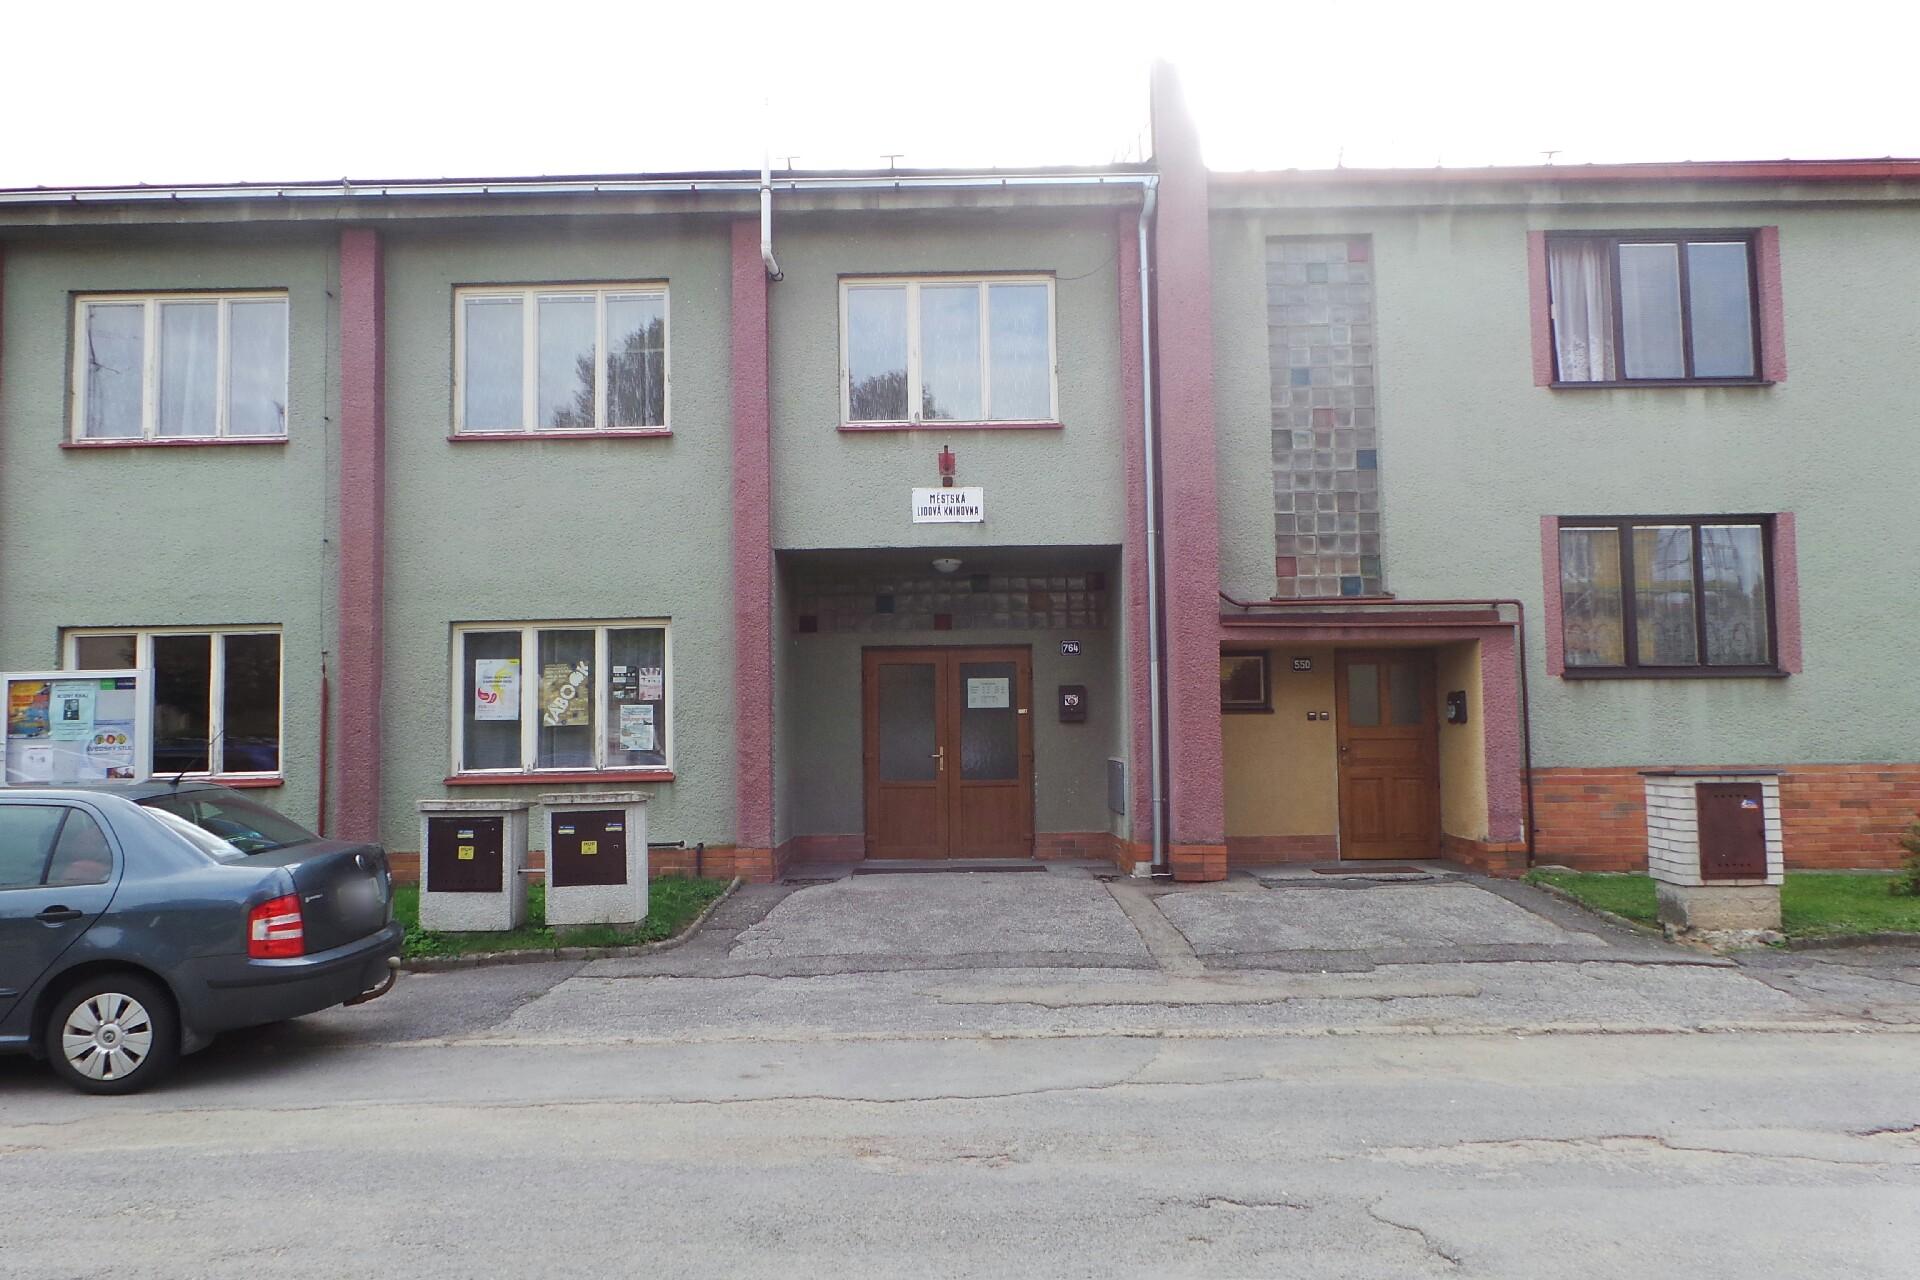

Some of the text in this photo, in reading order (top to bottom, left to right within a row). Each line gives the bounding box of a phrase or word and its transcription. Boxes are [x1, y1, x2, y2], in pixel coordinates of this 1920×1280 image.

[929, 492, 966, 503] MĚSTSKÁ
[917, 505, 978, 516] LIDOVÁ KNIHOVNA
[1063, 642, 1079, 653] 764
[1294, 659, 1311, 669] 550
